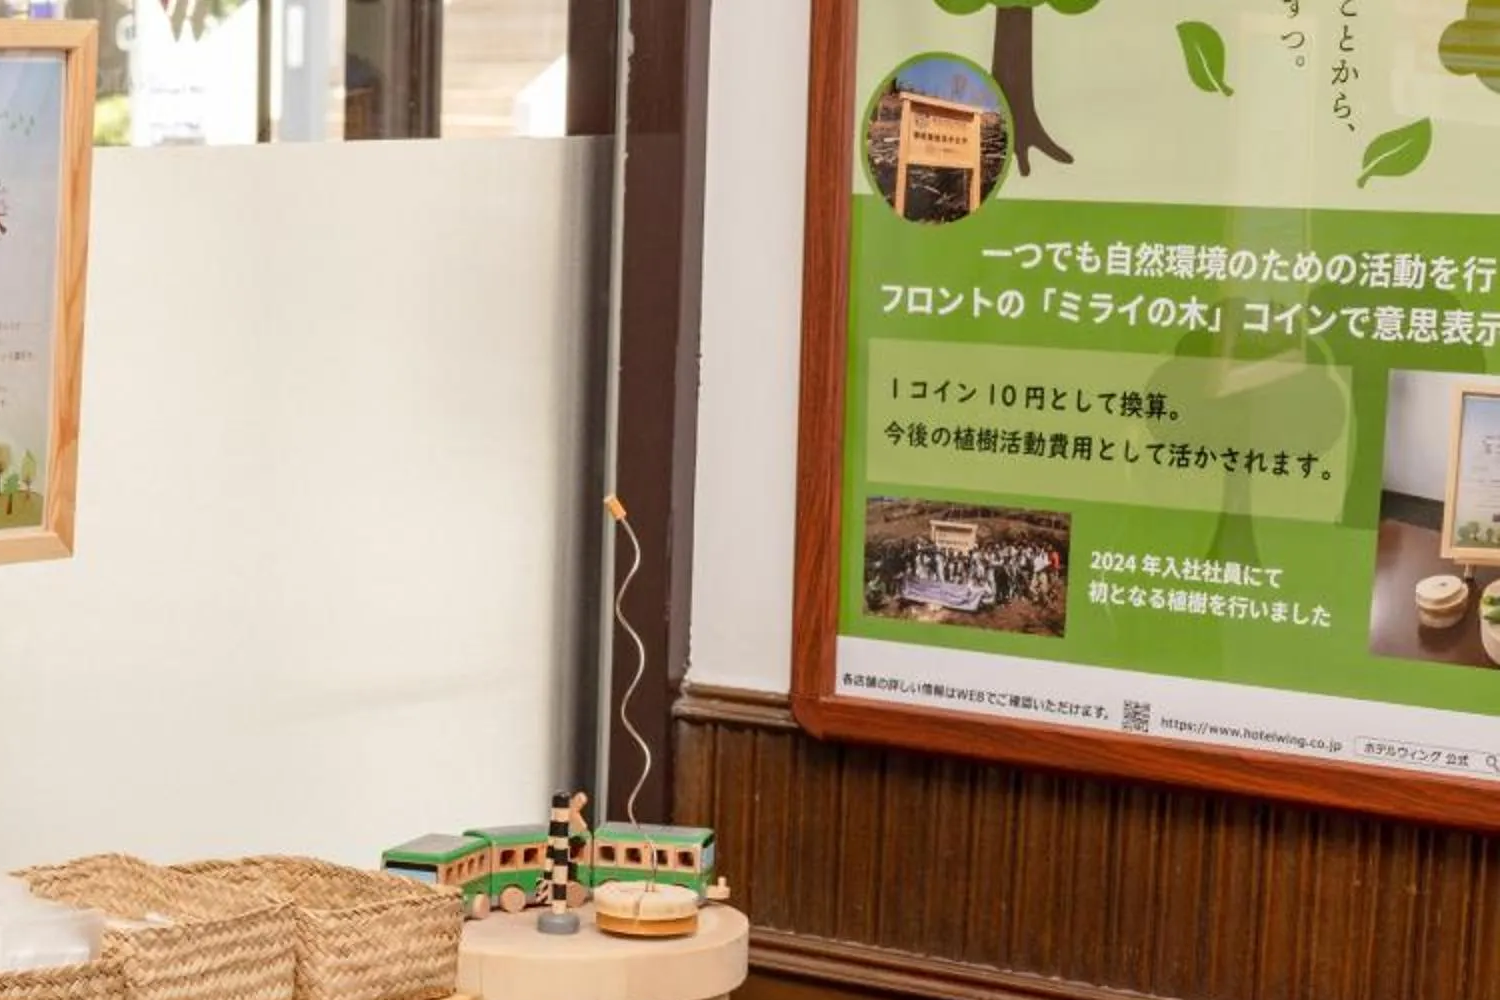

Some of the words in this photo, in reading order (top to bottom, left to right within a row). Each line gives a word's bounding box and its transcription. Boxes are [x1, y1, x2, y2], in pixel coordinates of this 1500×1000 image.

[982, 241, 1497, 293] 一つでも自然環境のための活動を行
[884, 421, 1331, 481] 今後の植樹活動費用として活かされます。
[1088, 580, 1331, 627] 初となる植樹を行いました
[1161, 717, 1343, 752] https://www.hotelwing.co.jp
